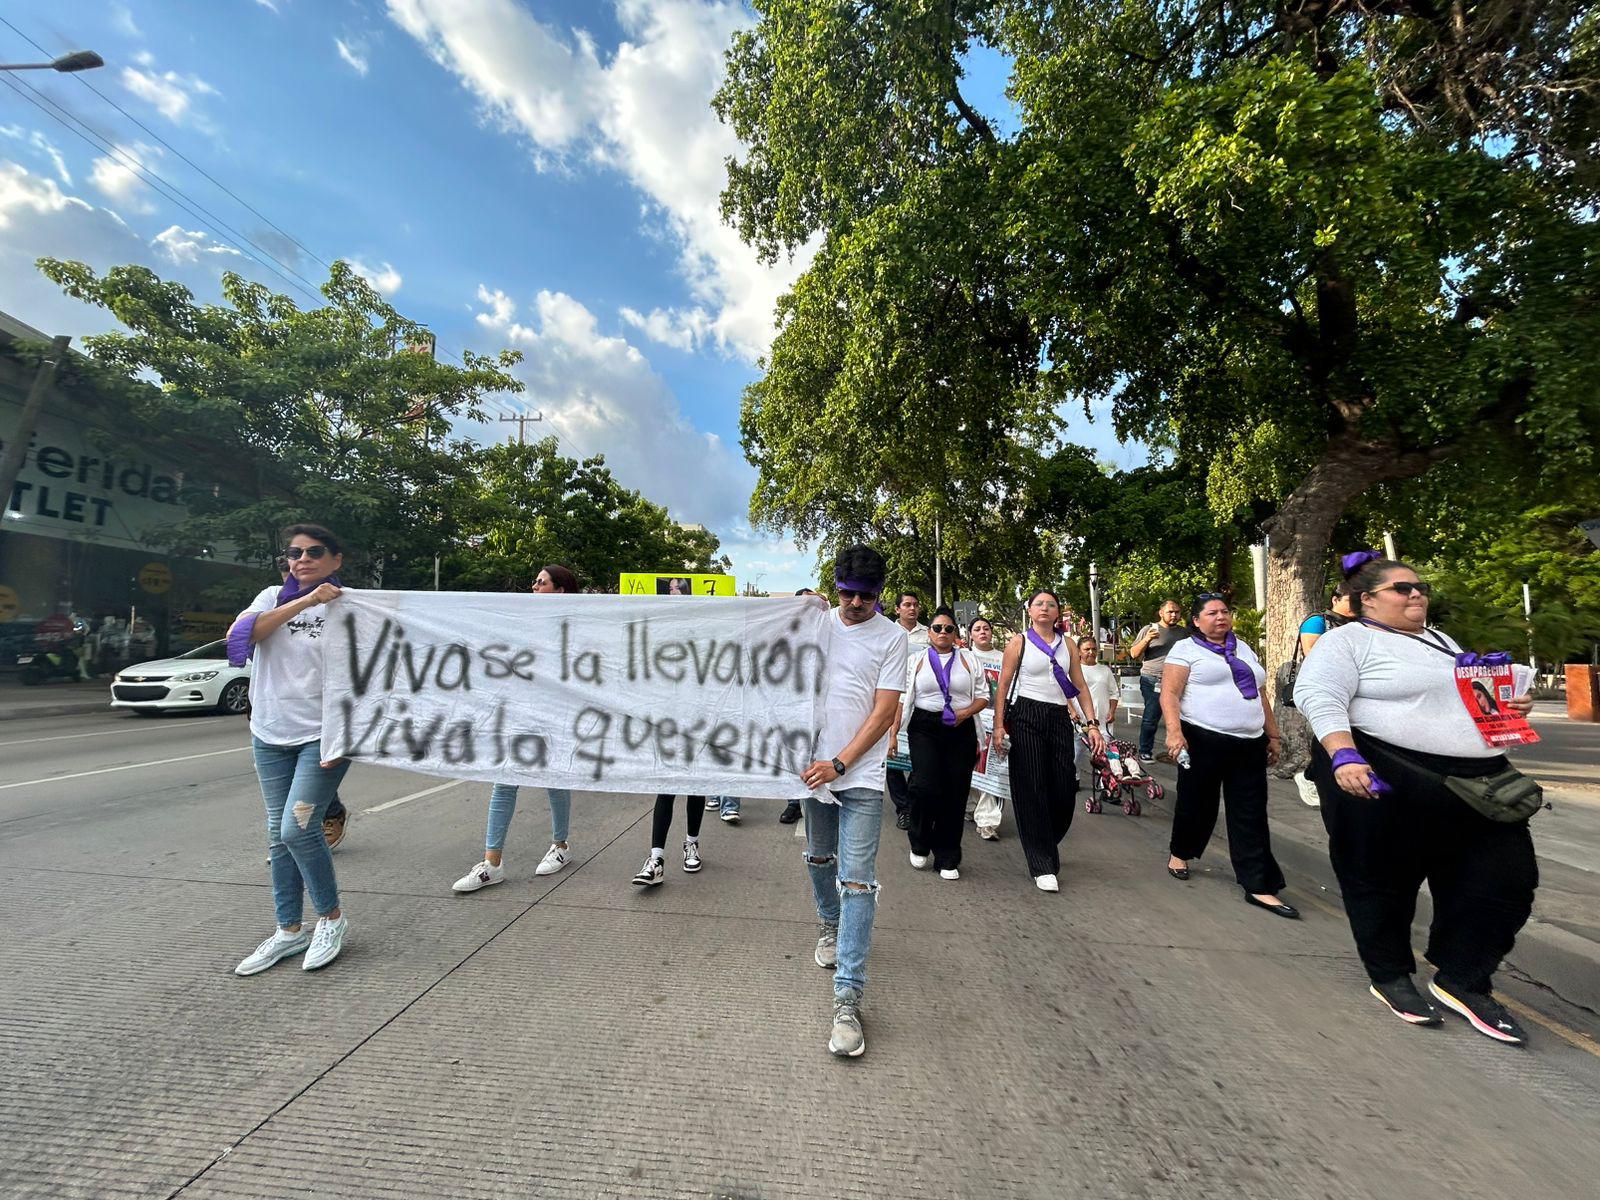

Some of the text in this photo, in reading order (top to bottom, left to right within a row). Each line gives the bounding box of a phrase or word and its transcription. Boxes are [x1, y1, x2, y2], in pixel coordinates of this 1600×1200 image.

[628, 579, 646, 594] YA
[560, 618, 602, 685] la
[1456, 664, 1510, 679] DESAPARECIDA
